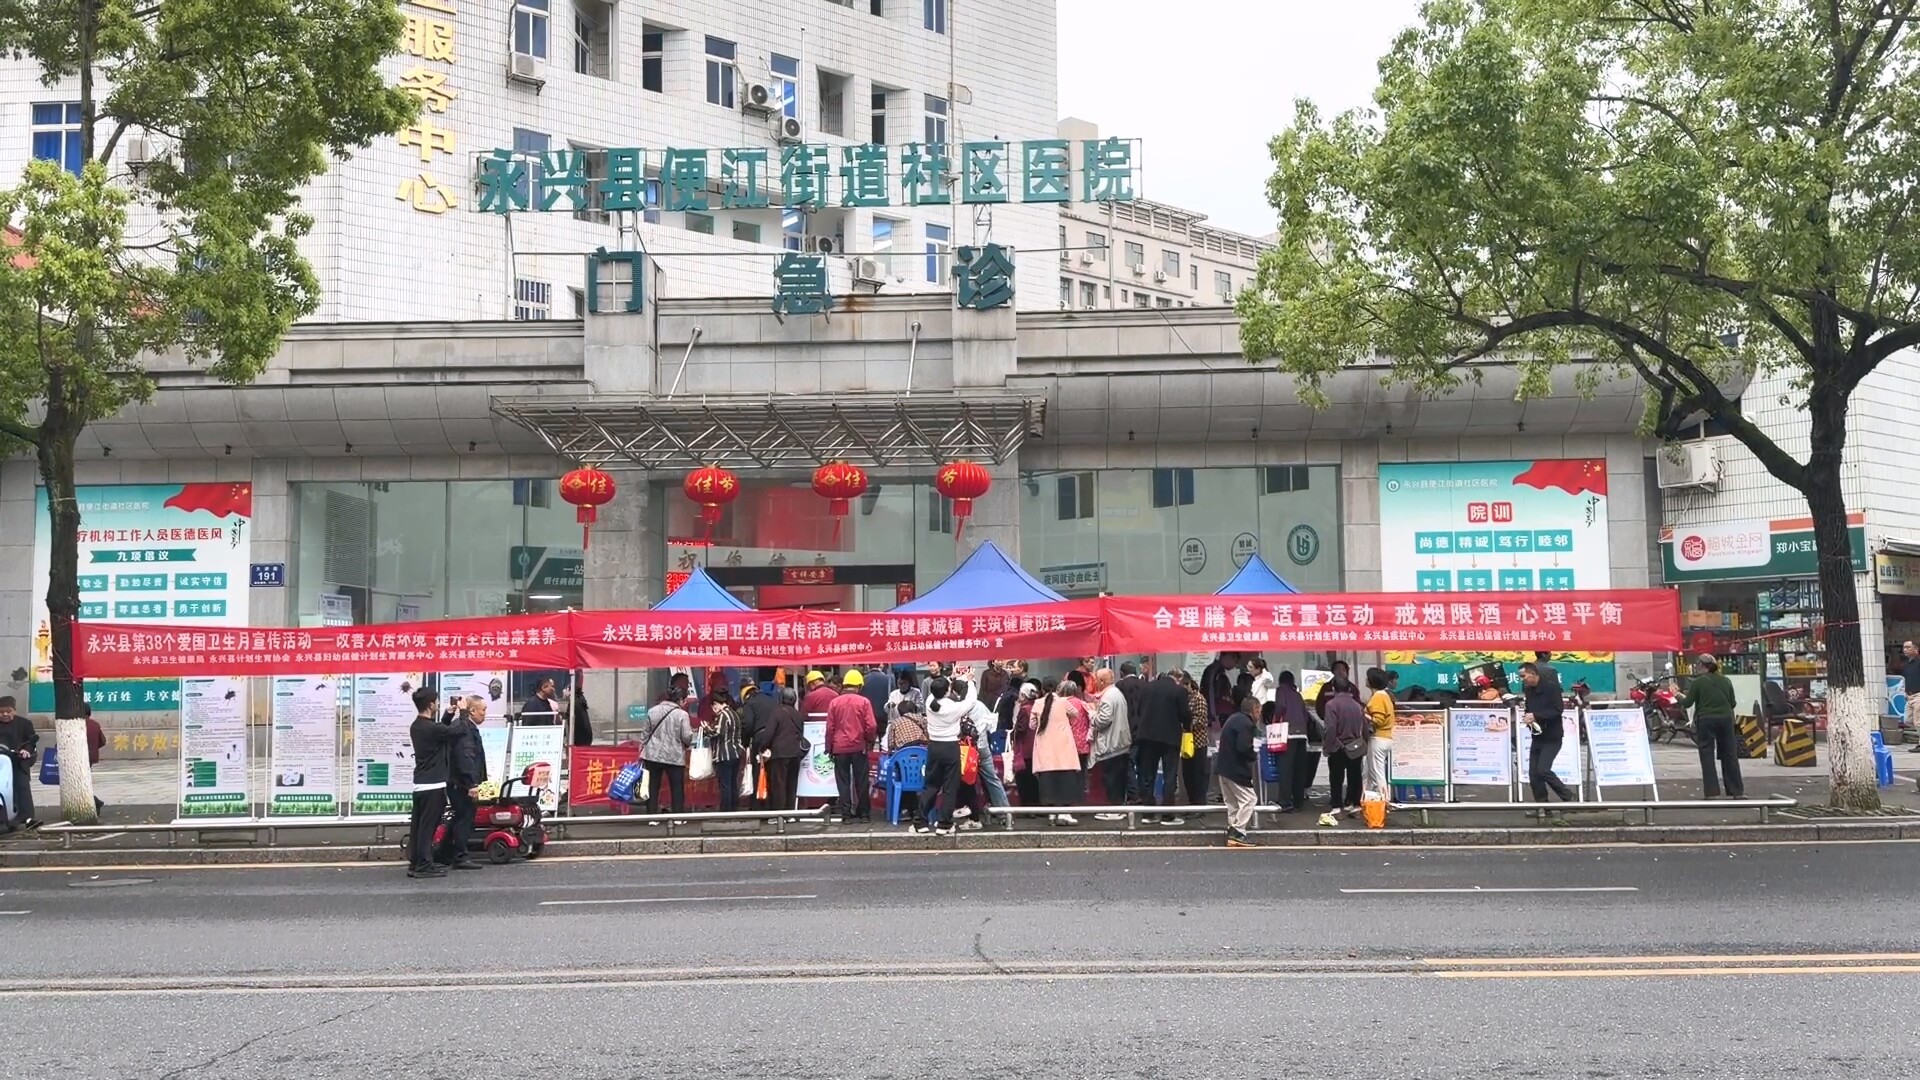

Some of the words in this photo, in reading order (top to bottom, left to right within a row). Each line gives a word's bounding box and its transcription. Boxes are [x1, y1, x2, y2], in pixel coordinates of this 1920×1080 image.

[395, 0, 456, 214] 服务中心
[478, 137, 1133, 215] 永兴县便江街道社区医院
[1470, 504, 1511, 521] 院训
[117, 550, 170, 562] 九项倡议
[179, 576, 223, 587] 诚实守信
[258, 571, 276, 581] 191
[179, 603, 222, 614] 勇于创新
[1153, 604, 1253, 629] 合理膳食
[1272, 602, 1375, 627] 适量运动
[1395, 602, 1502, 626] 戒烟限酒
[1516, 601, 1623, 626] 心理平衡
[972, 614, 1067, 633] 共筑健康防线
[1201, 631, 1269, 642] 永兴县卫生健康局
[1279, 631, 1358, 641] 永兴县计划生育协会
[1363, 630, 1426, 641] 永兴县疾控中心
[1562, 630, 1572, 641] 宣
[132, 655, 205, 665] 永兴县卫生健康局
[209, 653, 291, 664] 永兴县计划生育协会
[439, 649, 505, 660] 永兴县疾控中心
[739, 645, 811, 655] 永兴县计划生育协会
